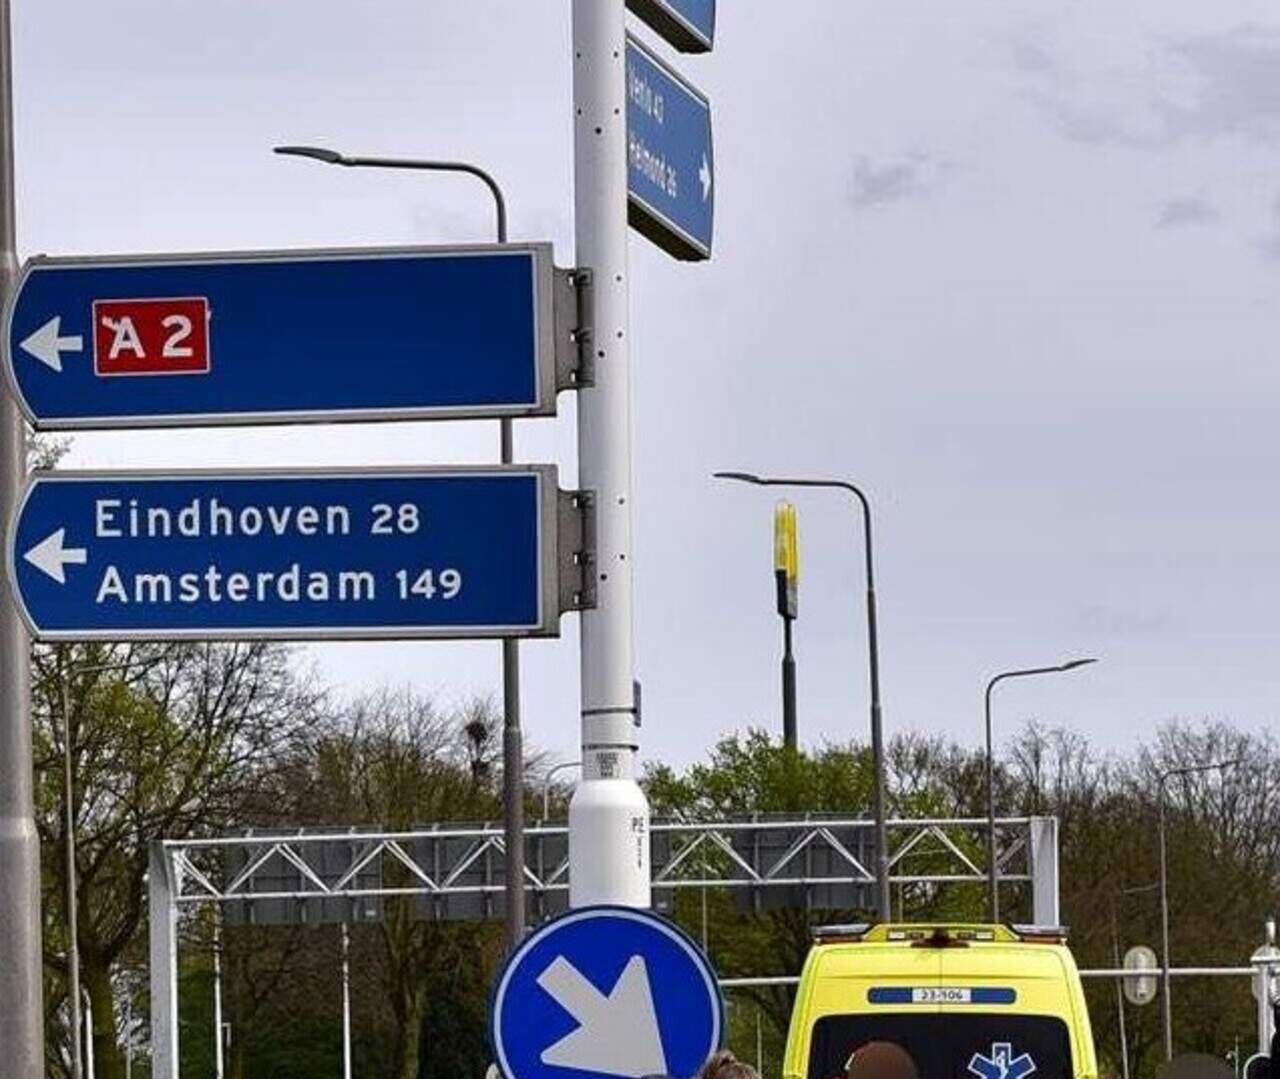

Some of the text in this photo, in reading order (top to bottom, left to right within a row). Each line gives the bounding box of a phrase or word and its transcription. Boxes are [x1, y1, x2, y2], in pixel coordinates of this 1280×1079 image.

[161, 314, 194, 358] 2
[95, 500, 420, 538] Eindhoven 28
[95, 562, 462, 604] Amsterdam 149
